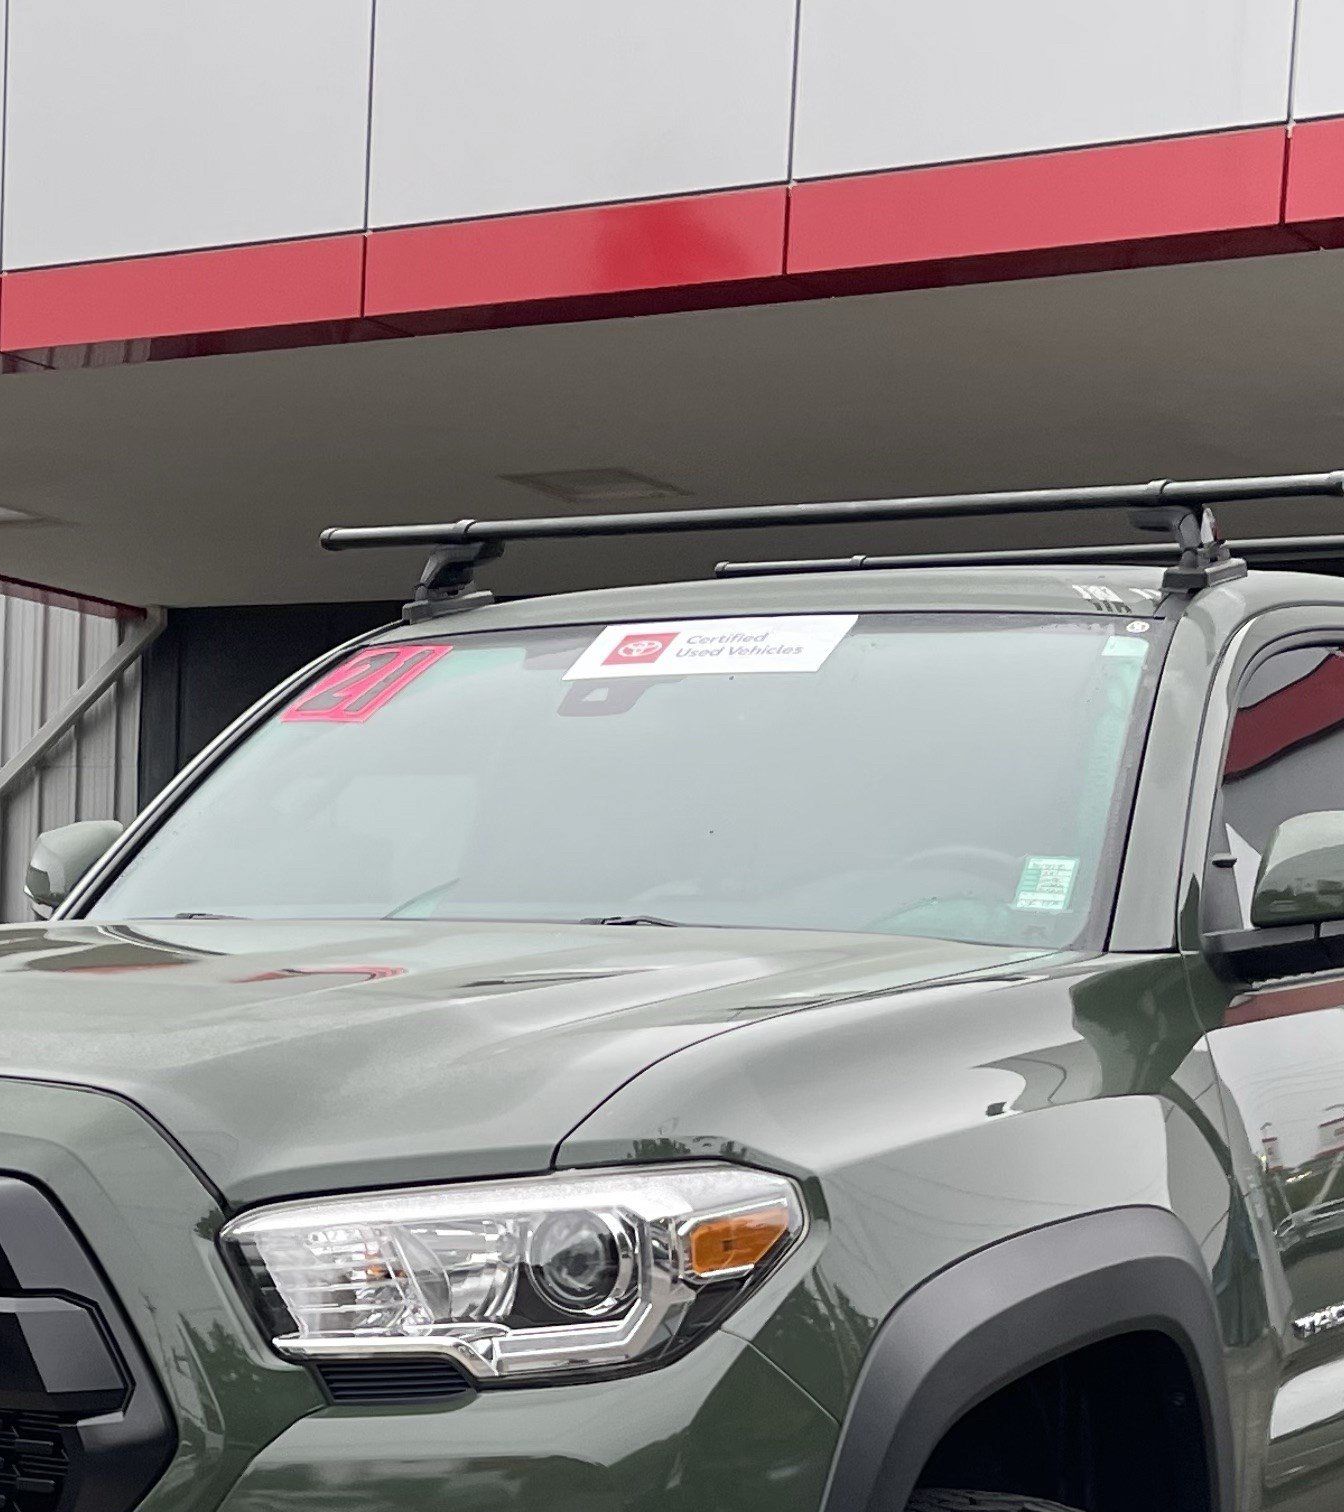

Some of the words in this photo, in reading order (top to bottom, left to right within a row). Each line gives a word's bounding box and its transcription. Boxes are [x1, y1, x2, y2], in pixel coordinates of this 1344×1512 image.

[686, 632, 769, 646] Certified
[675, 647, 722, 659] Used
[728, 644, 804, 656] Vehicles
[295, 649, 436, 712] 21
